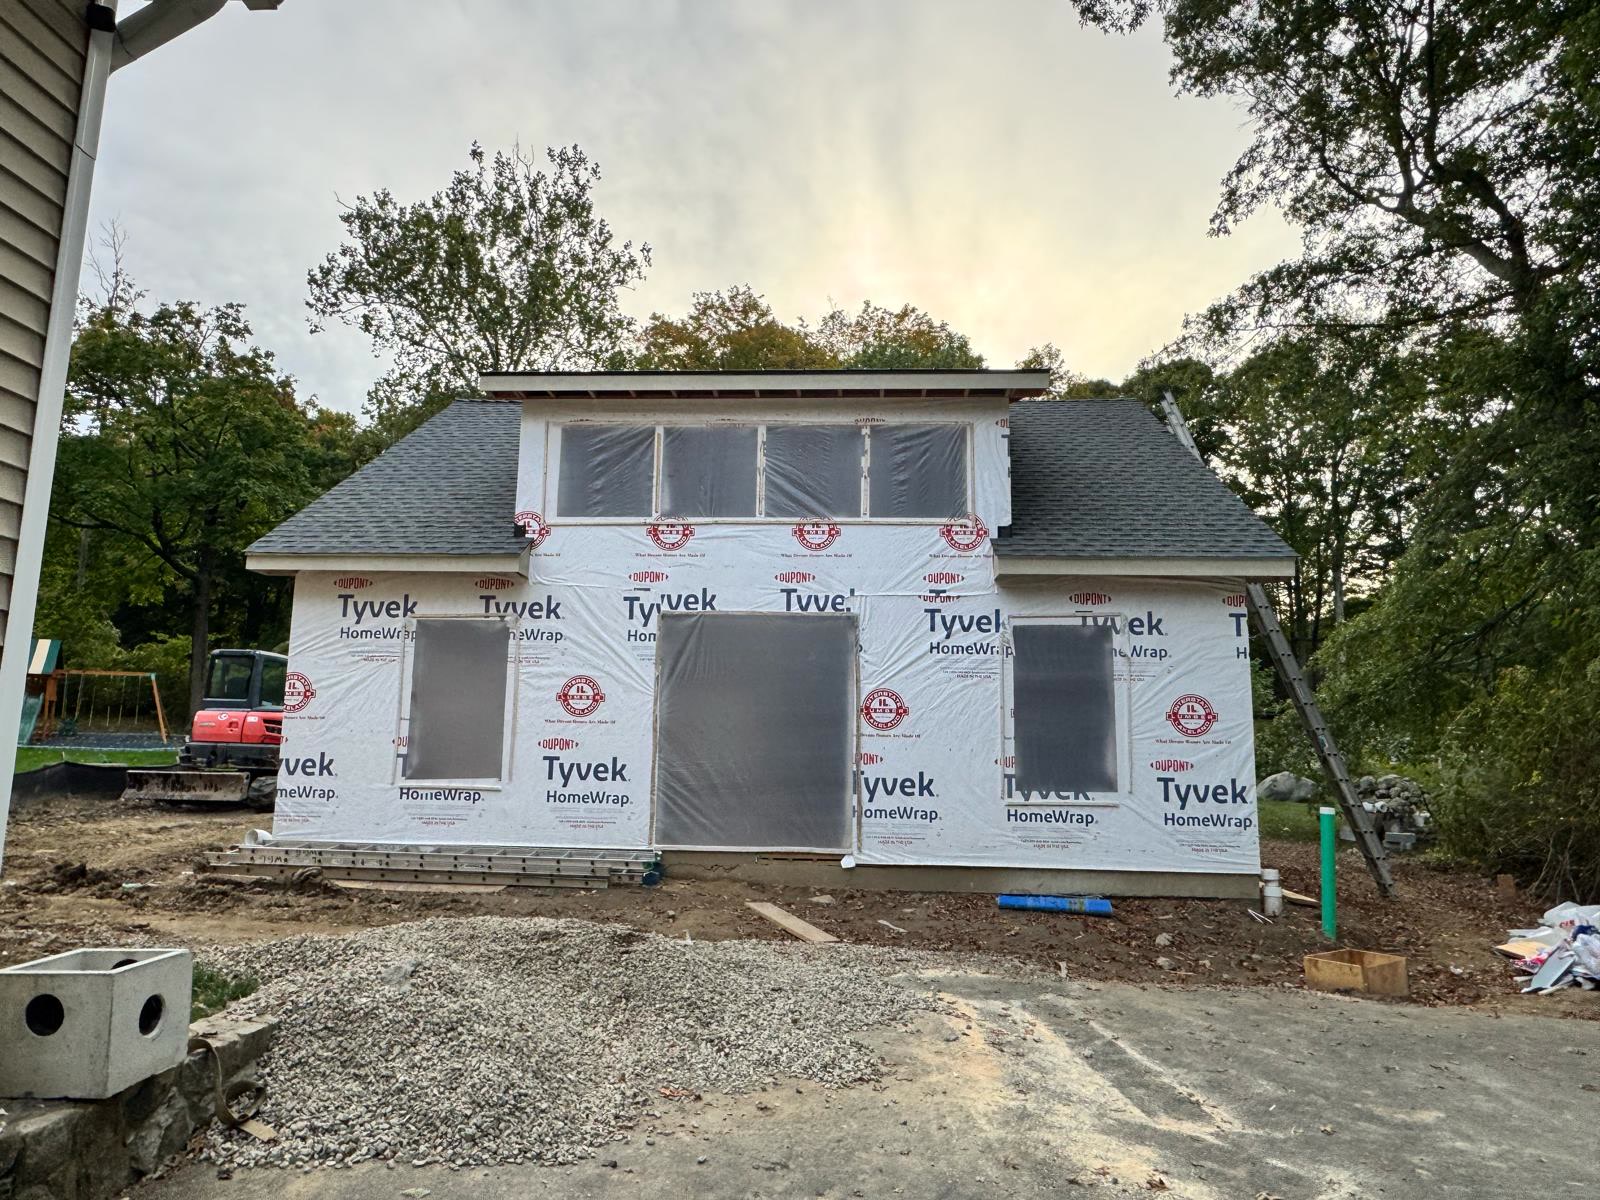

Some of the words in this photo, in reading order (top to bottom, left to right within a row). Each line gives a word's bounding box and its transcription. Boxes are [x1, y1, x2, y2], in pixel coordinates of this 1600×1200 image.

[948, 535, 982, 550] LAKELAND
[338, 577, 369, 589] DUPONT
[479, 578, 511, 590] DUPONT
[633, 571, 665, 583] DUPONT
[780, 571, 811, 584] DUPONT
[928, 572, 960, 585] DUPONT
[1074, 592, 1107, 605] DUPONT
[337, 594, 418, 624] Tyvek
[479, 595, 561, 622] Tyvek
[929, 641, 1014, 658] HomeWrp
[564, 701, 598, 715] LAKELAND
[1173, 697, 1211, 713] INTERSTATE
[866, 715, 900, 728] LAKELAND
[1175, 721, 1210, 735] LAKELAND
[542, 738, 575, 751] DUPONT
[280, 752, 336, 776] vek
[1155, 760, 1190, 772] DUPONT
[542, 756, 628, 788] Tyvek
[399, 788, 481, 804] HomeWrap
[546, 790, 630, 807] HomeWrap
[1156, 777, 1248, 810] Tyvek
[1007, 809, 1095, 827] HomeWrap
[1164, 813, 1253, 830] HomeWrap
